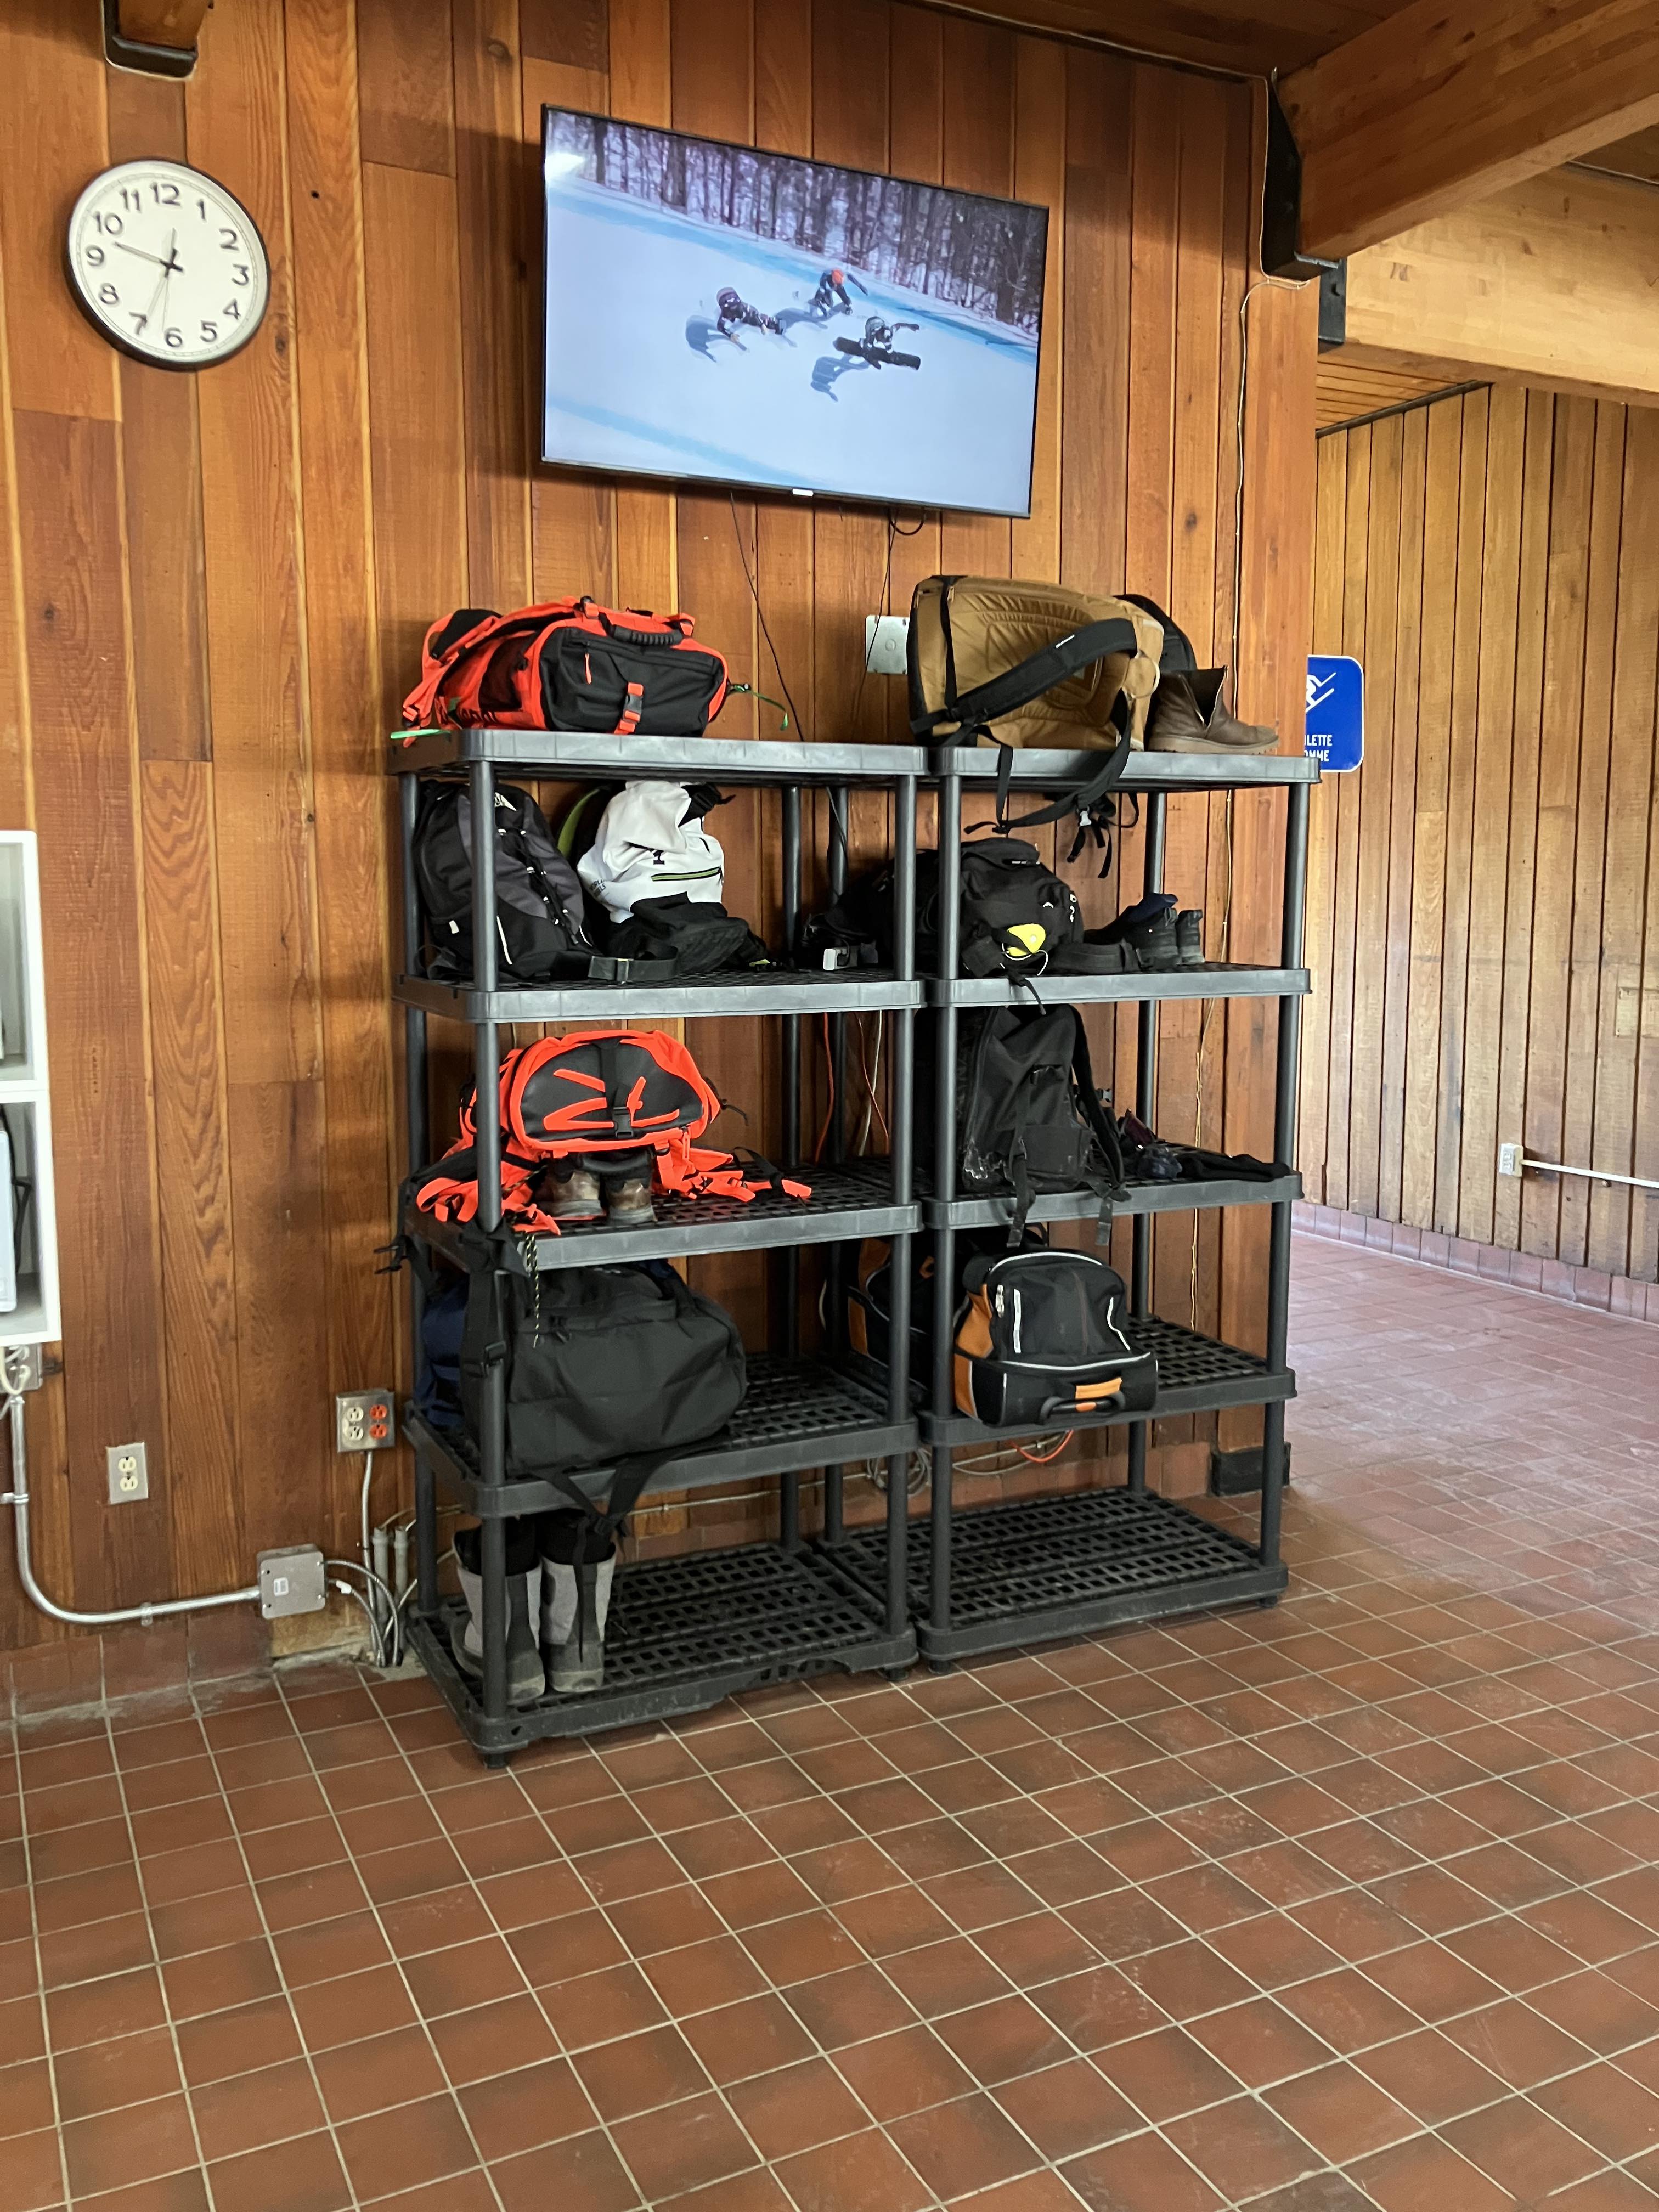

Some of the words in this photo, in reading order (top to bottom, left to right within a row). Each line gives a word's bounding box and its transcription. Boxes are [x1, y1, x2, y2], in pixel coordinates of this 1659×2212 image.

[120, 189, 141, 212] 11
[150, 182, 180, 206] 12
[197, 199, 206, 221] 1
[94, 211, 123, 234] 10
[219, 229, 239, 251] 2
[86, 245, 104, 267] 9
[232, 264, 249, 286] 3
[99, 283, 119, 305] 8
[223, 299, 240, 320] 4
[129, 311, 148, 335] 7
[200, 320, 217, 343] 5
[165, 327, 183, 348] 6
[1304, 734, 1333, 746] ILETTE
[1304, 750, 1329, 761] MME
